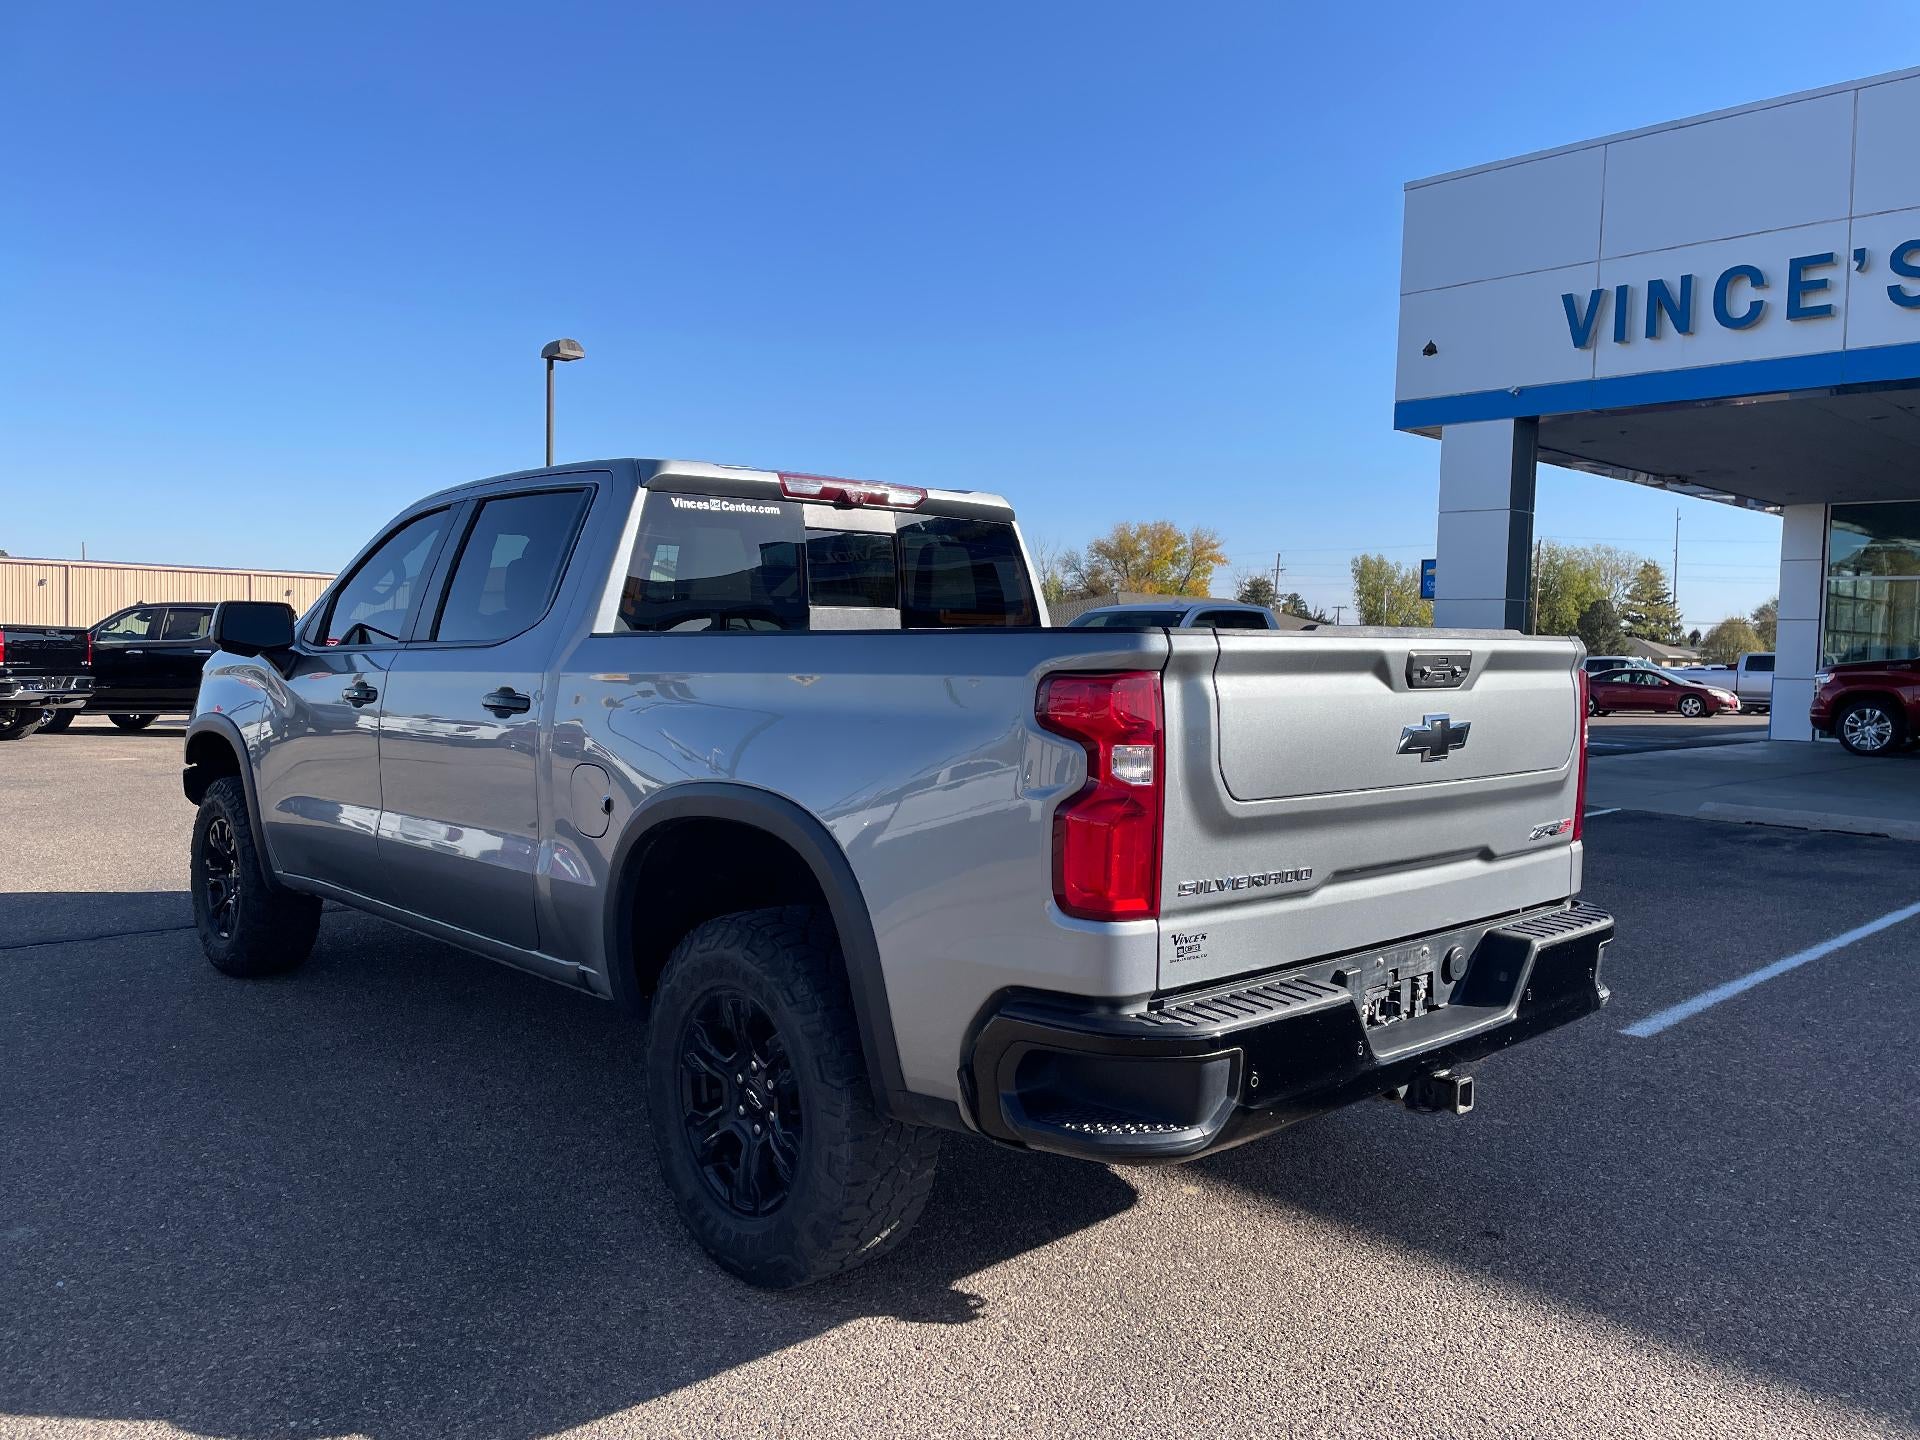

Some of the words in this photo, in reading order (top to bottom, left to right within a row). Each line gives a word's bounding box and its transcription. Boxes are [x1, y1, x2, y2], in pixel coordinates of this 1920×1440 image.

[1561, 239, 1920, 350] VINCE'S
[671, 498, 709, 510] Vinces
[722, 502, 780, 514] Center.com
[1178, 867, 1312, 897] SILVERADO
